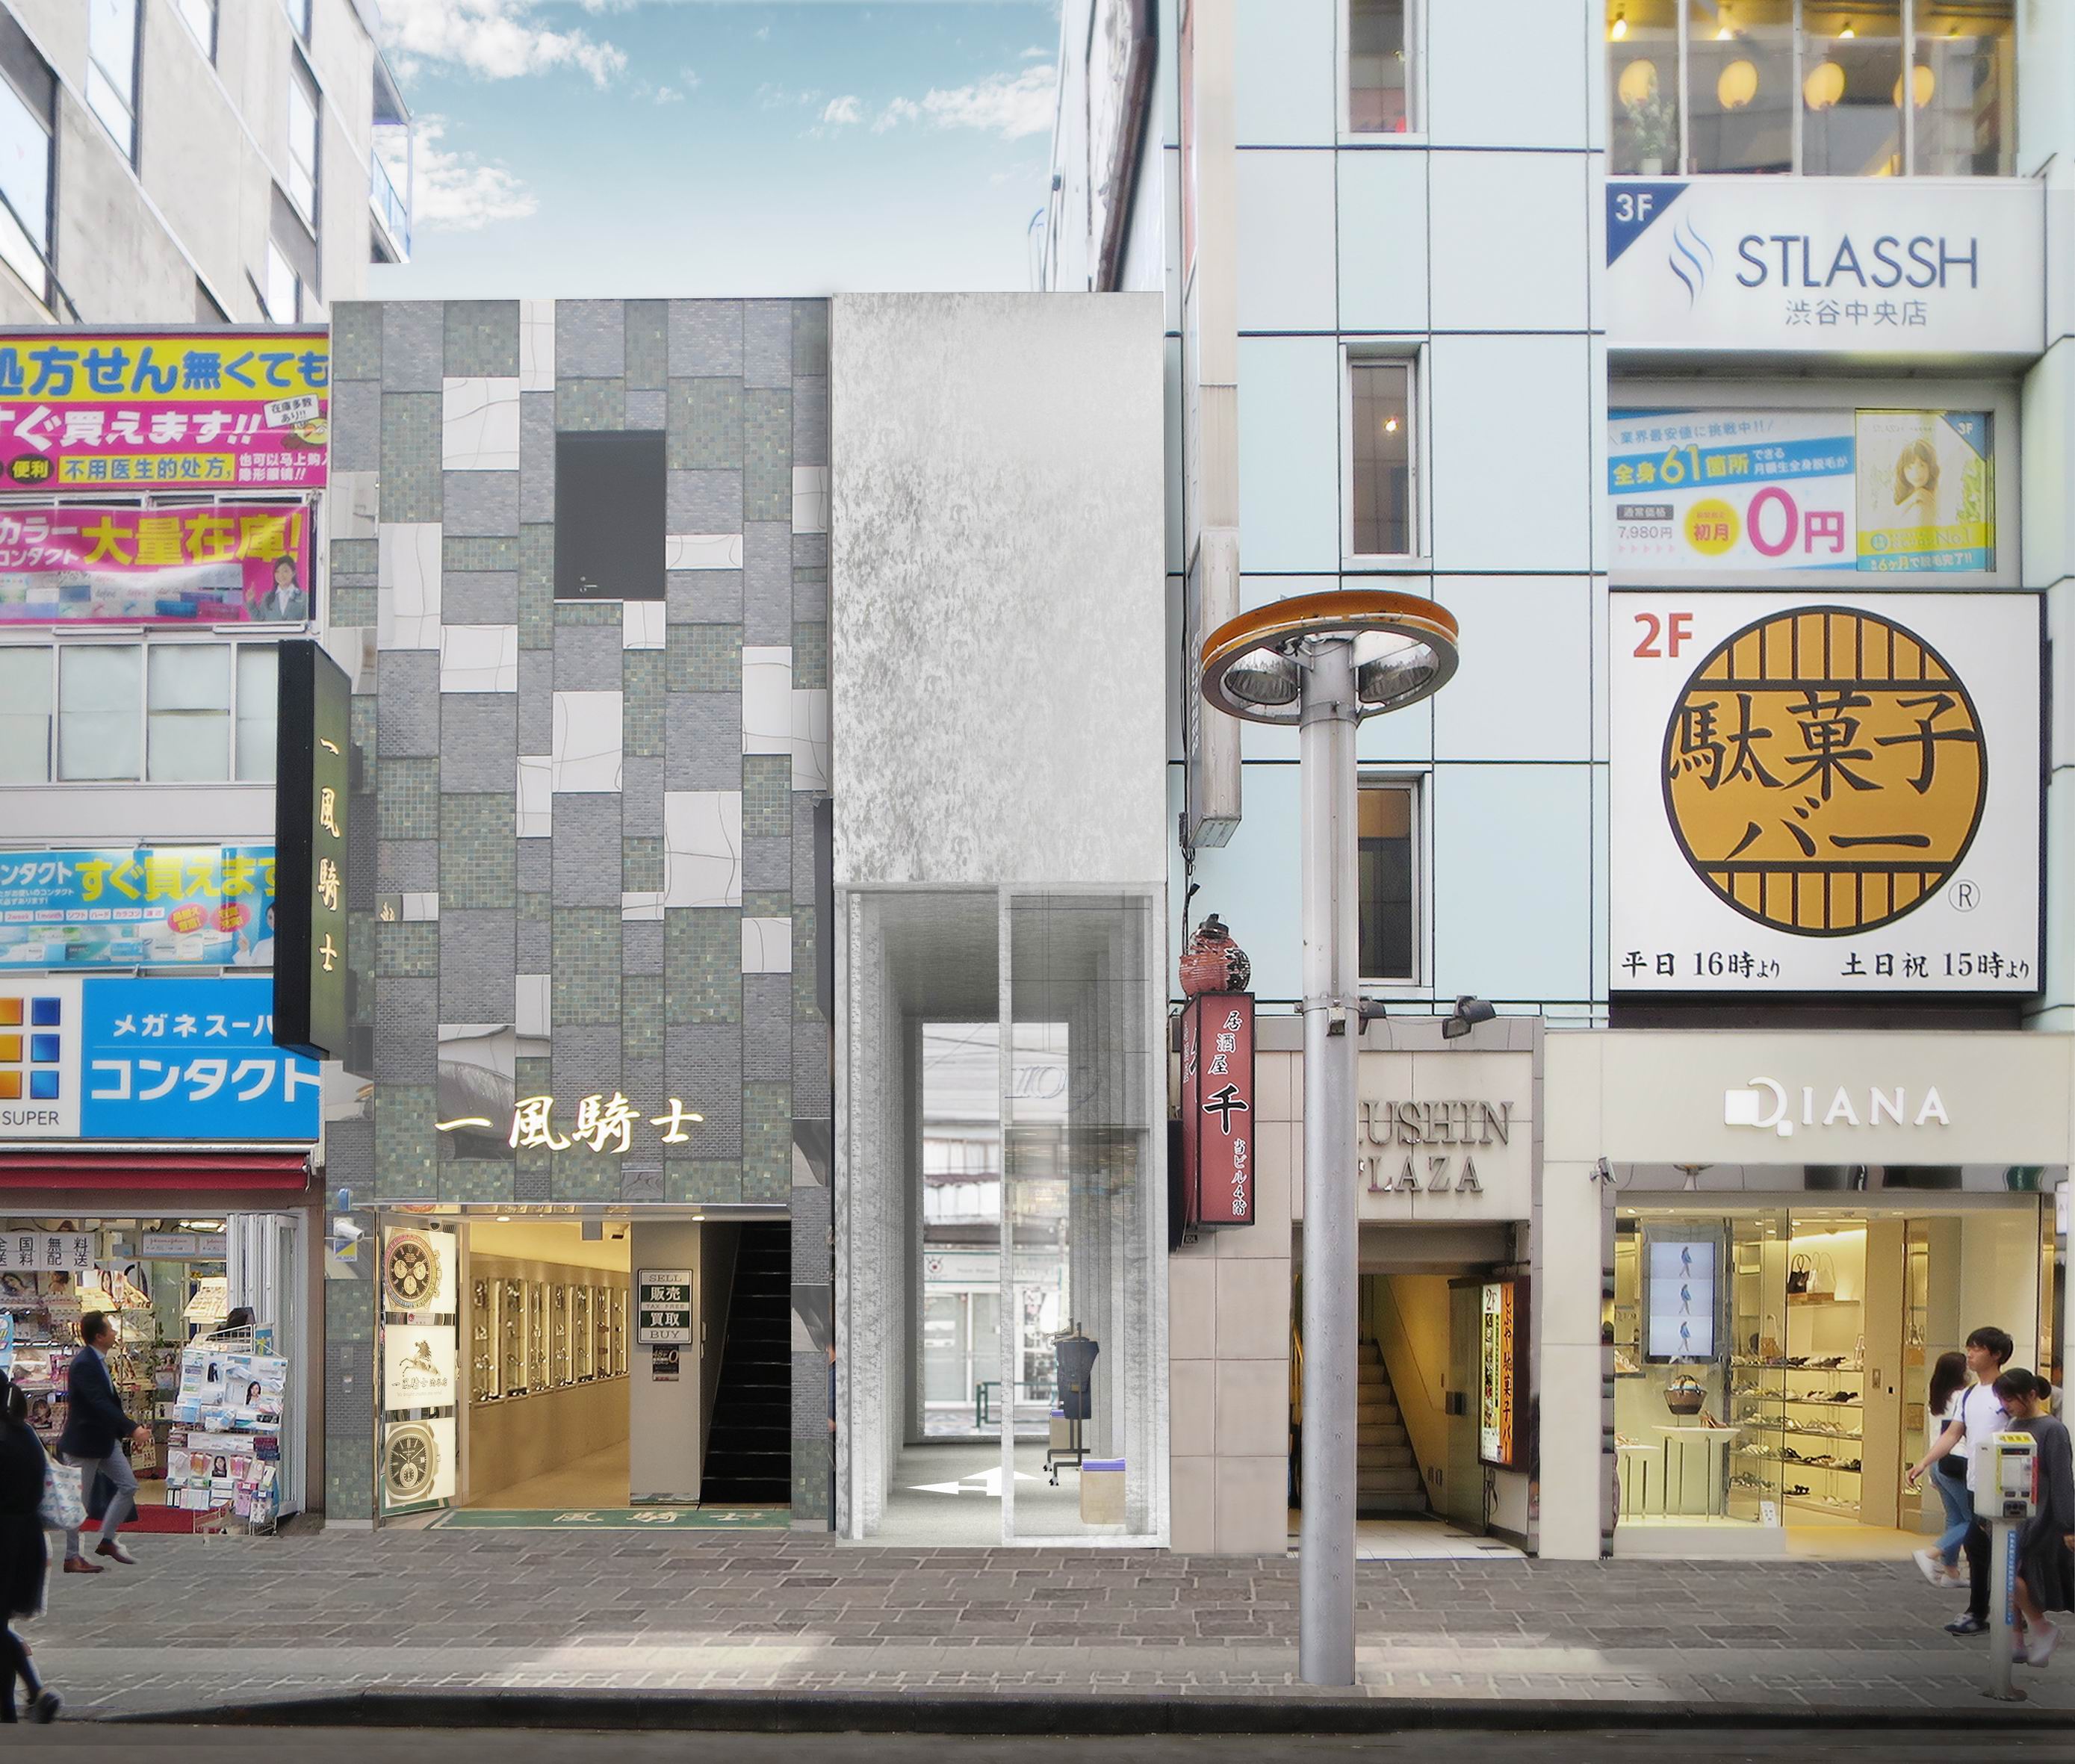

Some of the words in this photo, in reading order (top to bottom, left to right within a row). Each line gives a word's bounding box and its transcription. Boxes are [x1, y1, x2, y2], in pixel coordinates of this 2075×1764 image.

[1615, 193, 1654, 223] 3F
[1735, 235, 1977, 288] STLASSH
[1785, 299, 1928, 326] 渋谷中央店
[0, 405, 262, 451] ぐ買えます!!
[1957, 421, 1973, 435] 3F
[81, 512, 303, 565] 大量在庫!
[1618, 526, 1672, 539] 7,980円
[1693, 524, 1730, 541] 初月
[1747, 486, 1844, 556] 0円
[1633, 612, 1693, 658] 2F
[1670, 691, 1981, 801] 駄菓子
[1724, 795, 1931, 860] バー
[1621, 951, 1675, 978] 平日
[1694, 951, 1781, 979] 16時より
[1840, 950, 1929, 978] 土日祝
[1944, 951, 2030, 980] 15時より
[1206, 1010, 1244, 1075] 居酒屋
[91, 1058, 320, 1102] コンタクト
[2, 1111, 60, 1126] SUPER
[434, 1091, 704, 1155] 一風騎士
[1200, 1081, 1250, 1136] 千
[1359, 1100, 1515, 1145] USHIN
[1724, 1076, 1951, 1137] DIANA
[1359, 1157, 1484, 1193] LAZA
[648, 1274, 682, 1282] SELL
[650, 1286, 680, 1302] 販売
[649, 1330, 680, 1339] BUY
[650, 1312, 680, 1327] 買取
